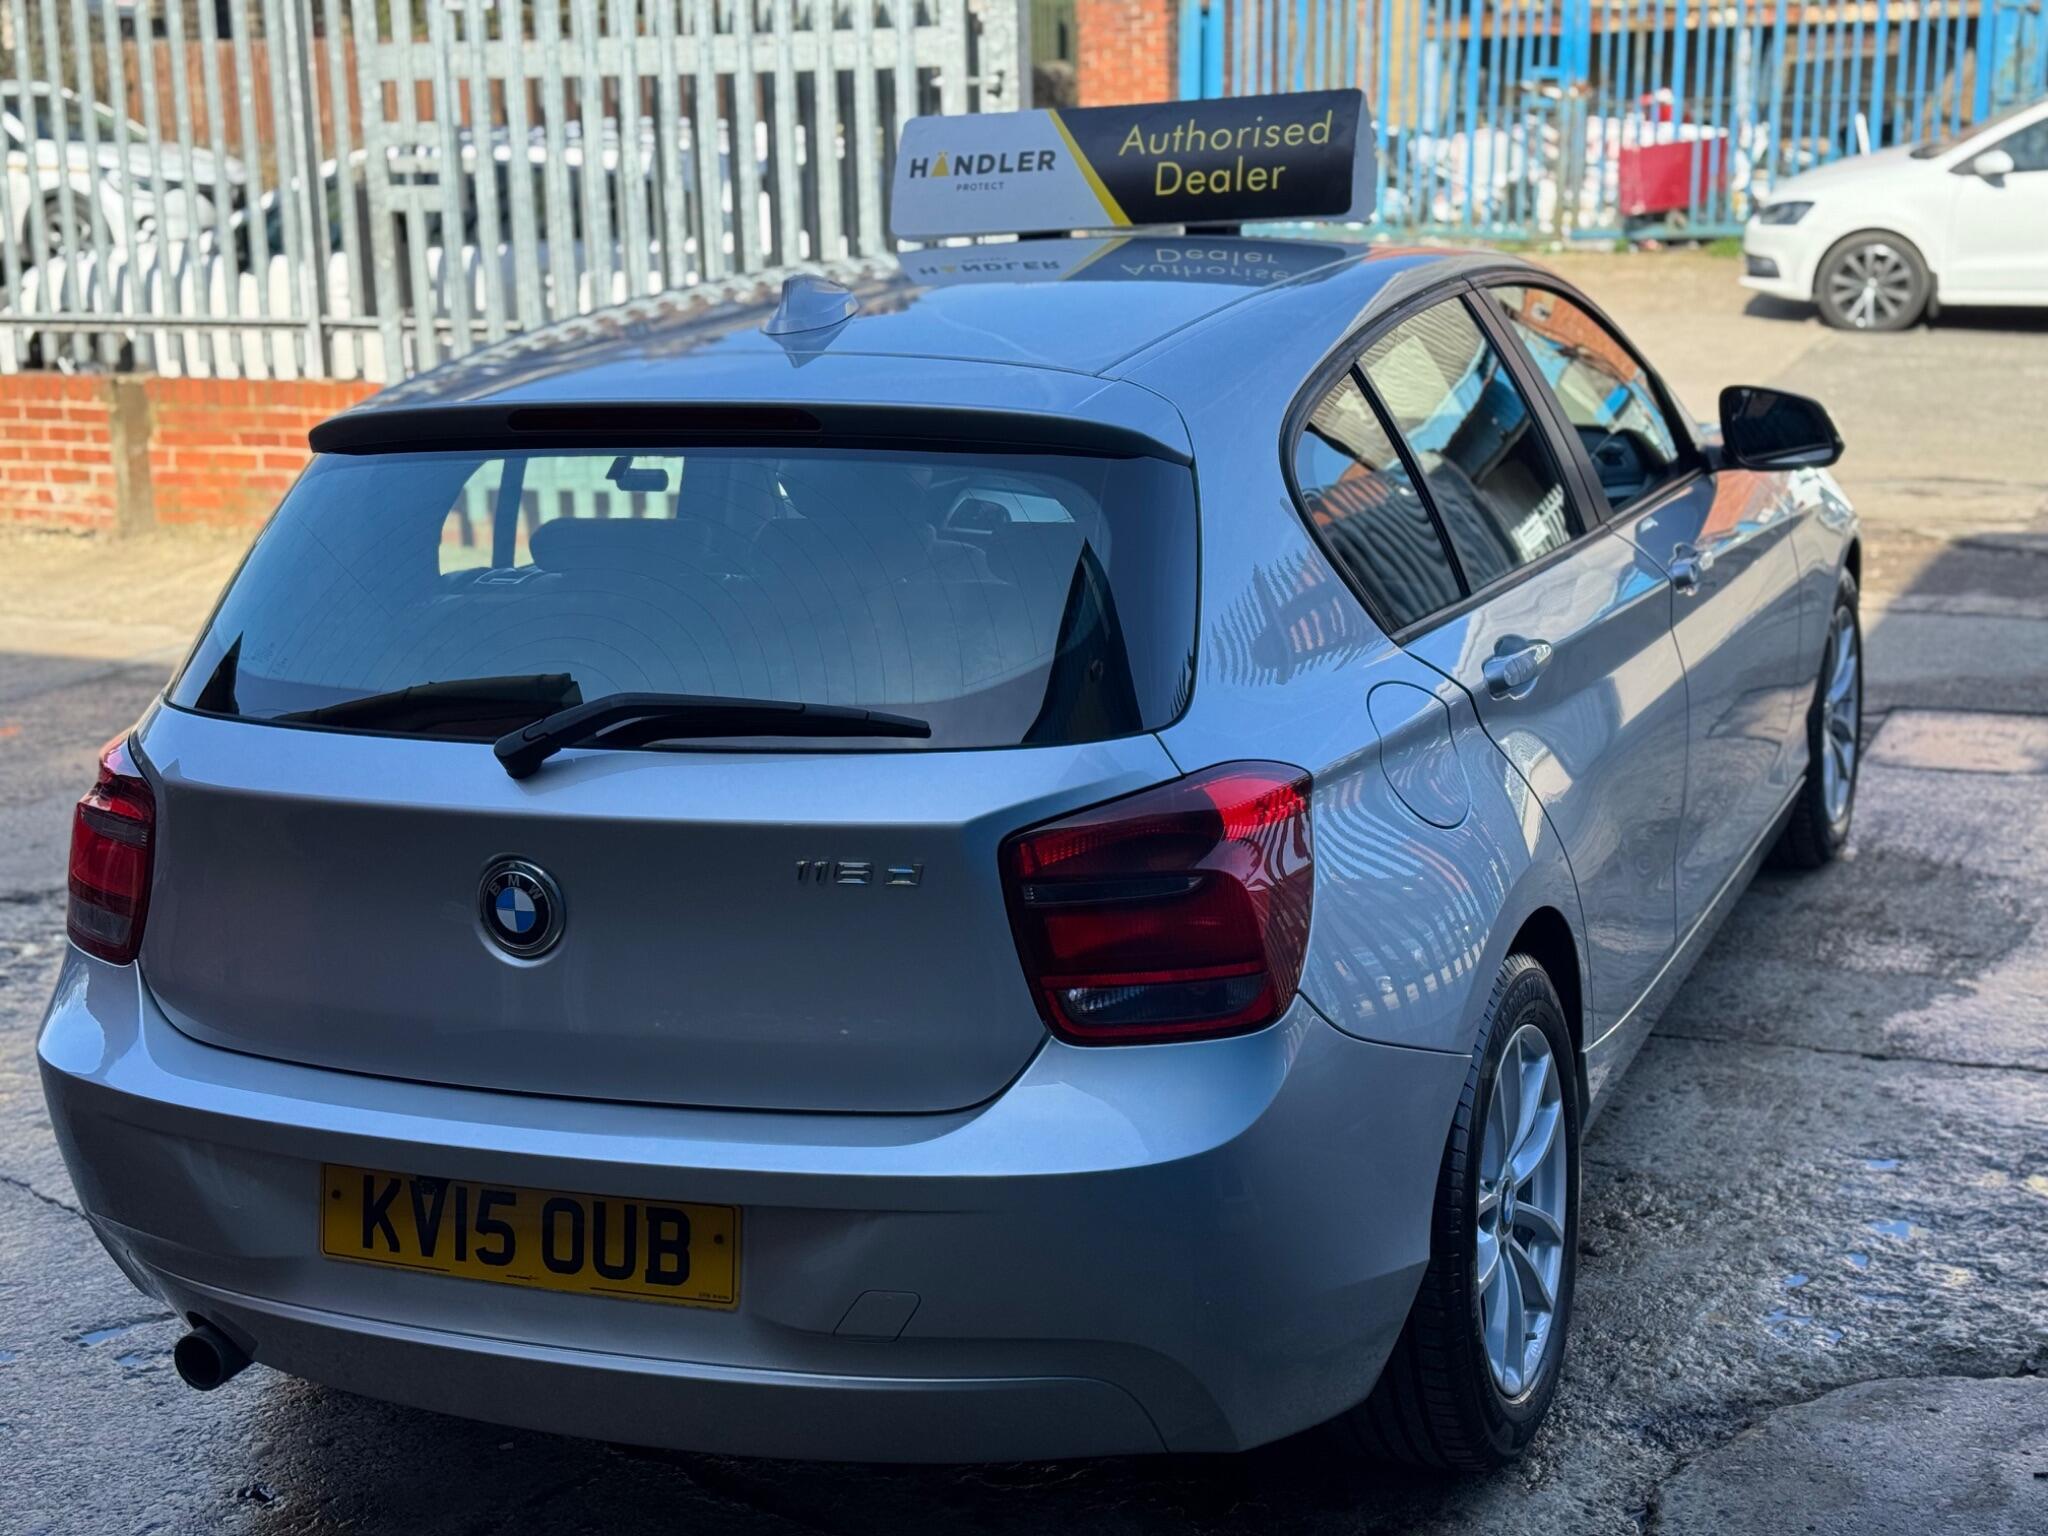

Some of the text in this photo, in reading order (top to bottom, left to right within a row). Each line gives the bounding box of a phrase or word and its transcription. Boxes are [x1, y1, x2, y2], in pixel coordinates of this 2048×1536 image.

[1118, 109, 1333, 156] Authorised
[956, 181, 1005, 192] PROTECT
[1155, 155, 1286, 196] Dealer
[488, 874, 543, 900] BMW
[362, 1174, 692, 1287] KV15 OUB
